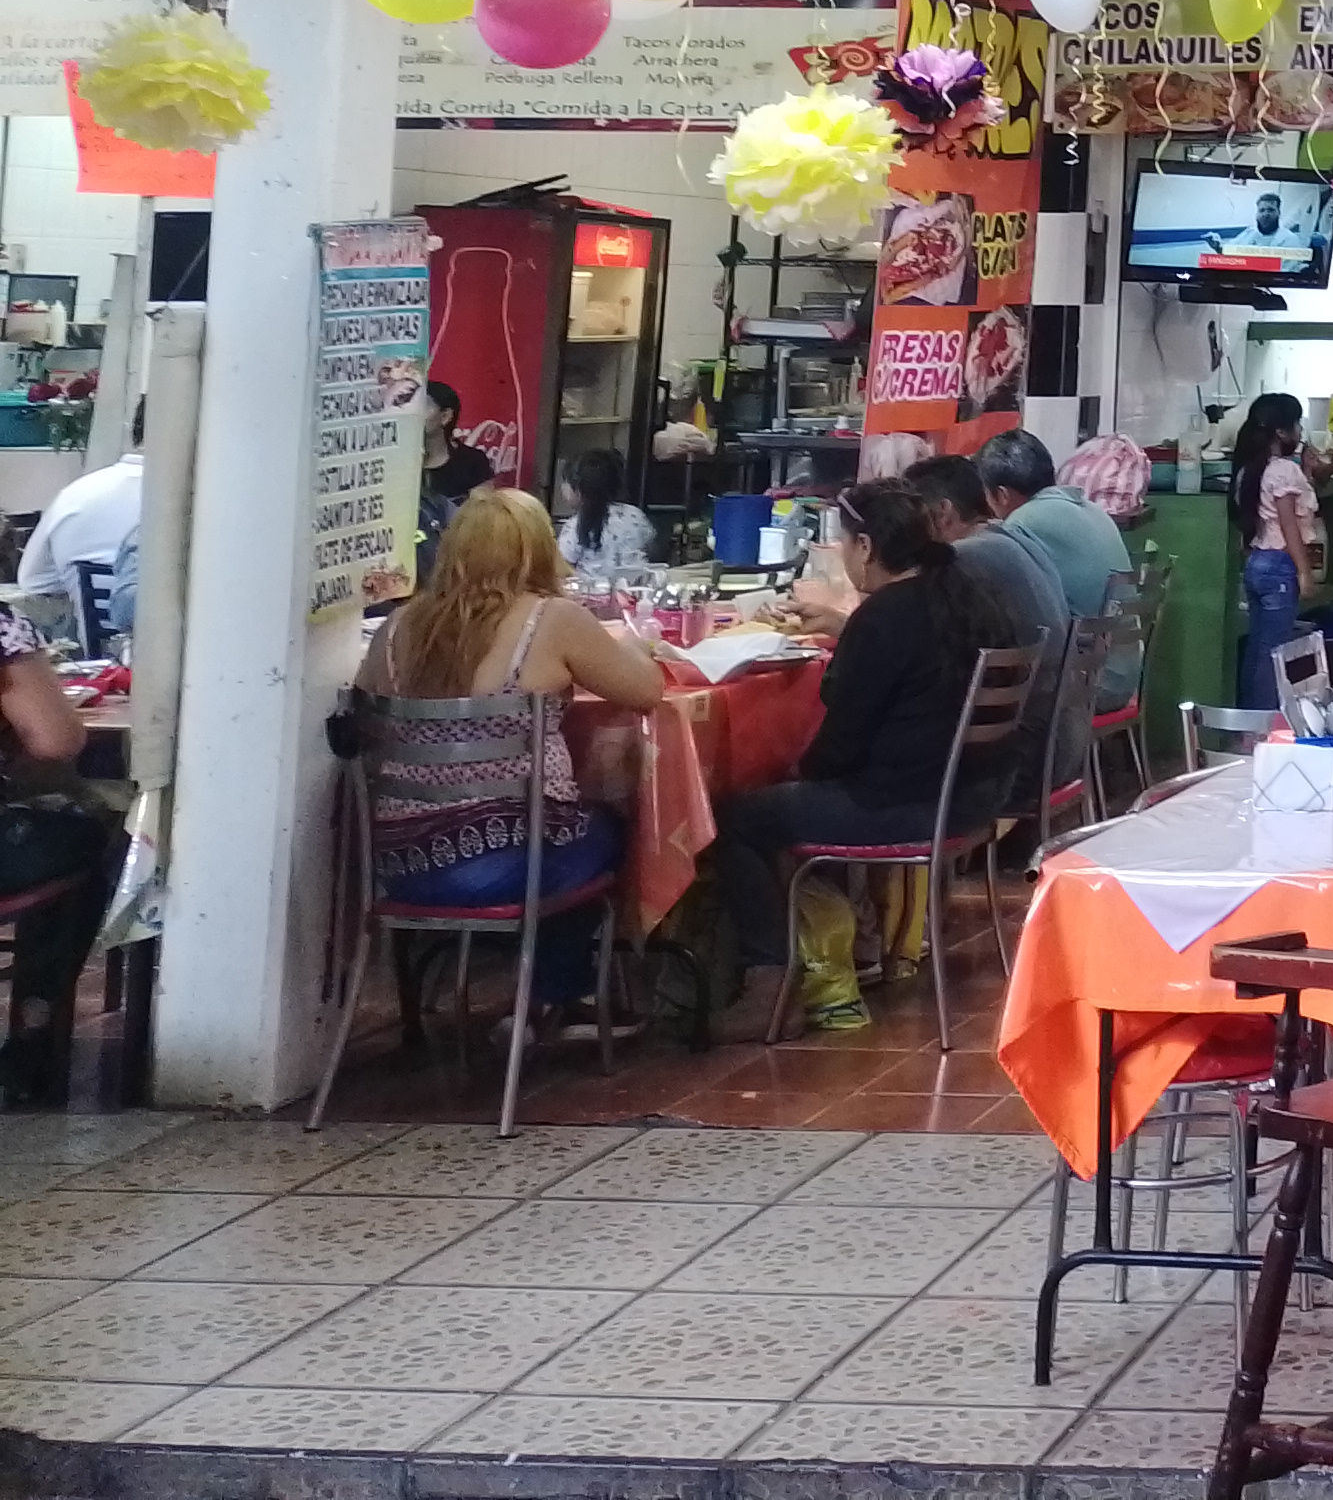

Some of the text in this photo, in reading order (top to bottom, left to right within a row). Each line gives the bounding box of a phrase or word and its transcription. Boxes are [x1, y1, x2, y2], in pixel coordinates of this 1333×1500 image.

[623, 35, 671, 49] Tacos
[633, 53, 719, 67] Arrachera
[485, 70, 624, 87] Pechuga Rellena
[439, 99, 515, 115] Corrida
